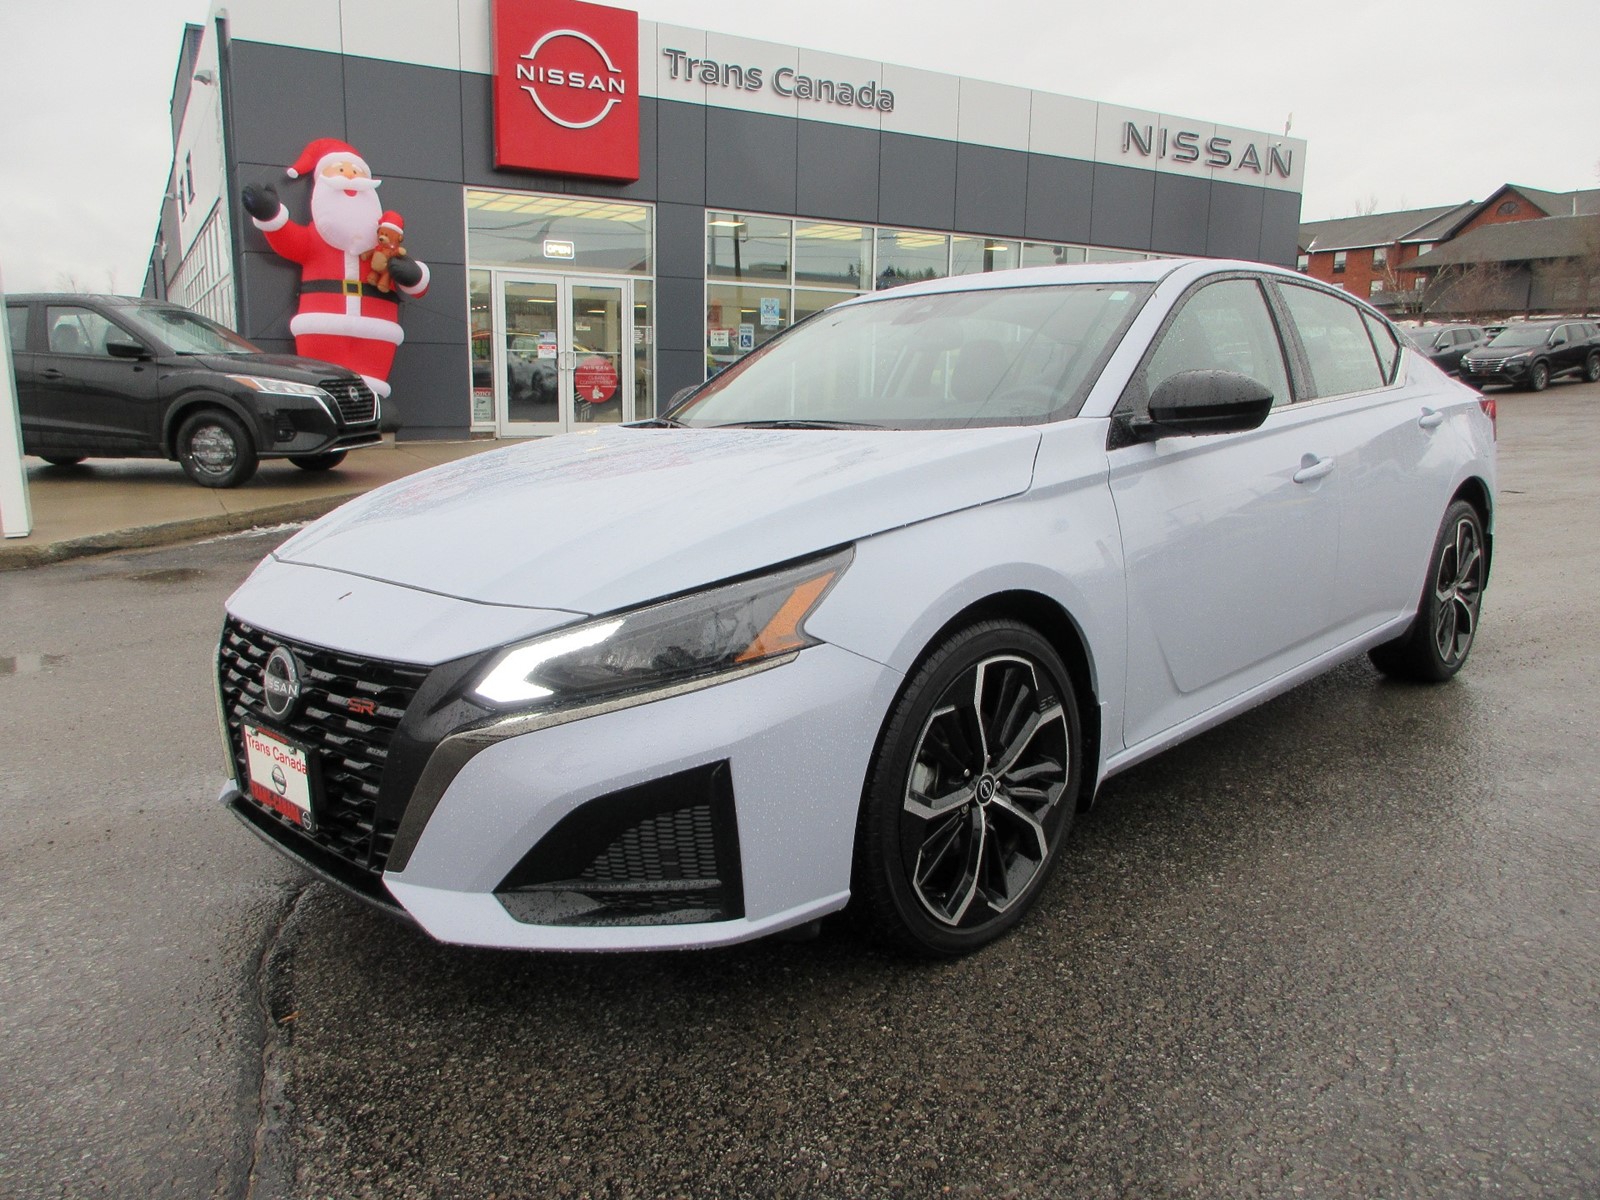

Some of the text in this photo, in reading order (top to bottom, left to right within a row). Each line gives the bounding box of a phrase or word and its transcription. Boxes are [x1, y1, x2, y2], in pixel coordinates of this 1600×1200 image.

[516, 63, 625, 95] NISSAN
[663, 48, 896, 113] Trans Canada
[1122, 121, 1293, 178] NISSAN
[348, 697, 375, 716] SR
[247, 733, 308, 775] Trans Canada
